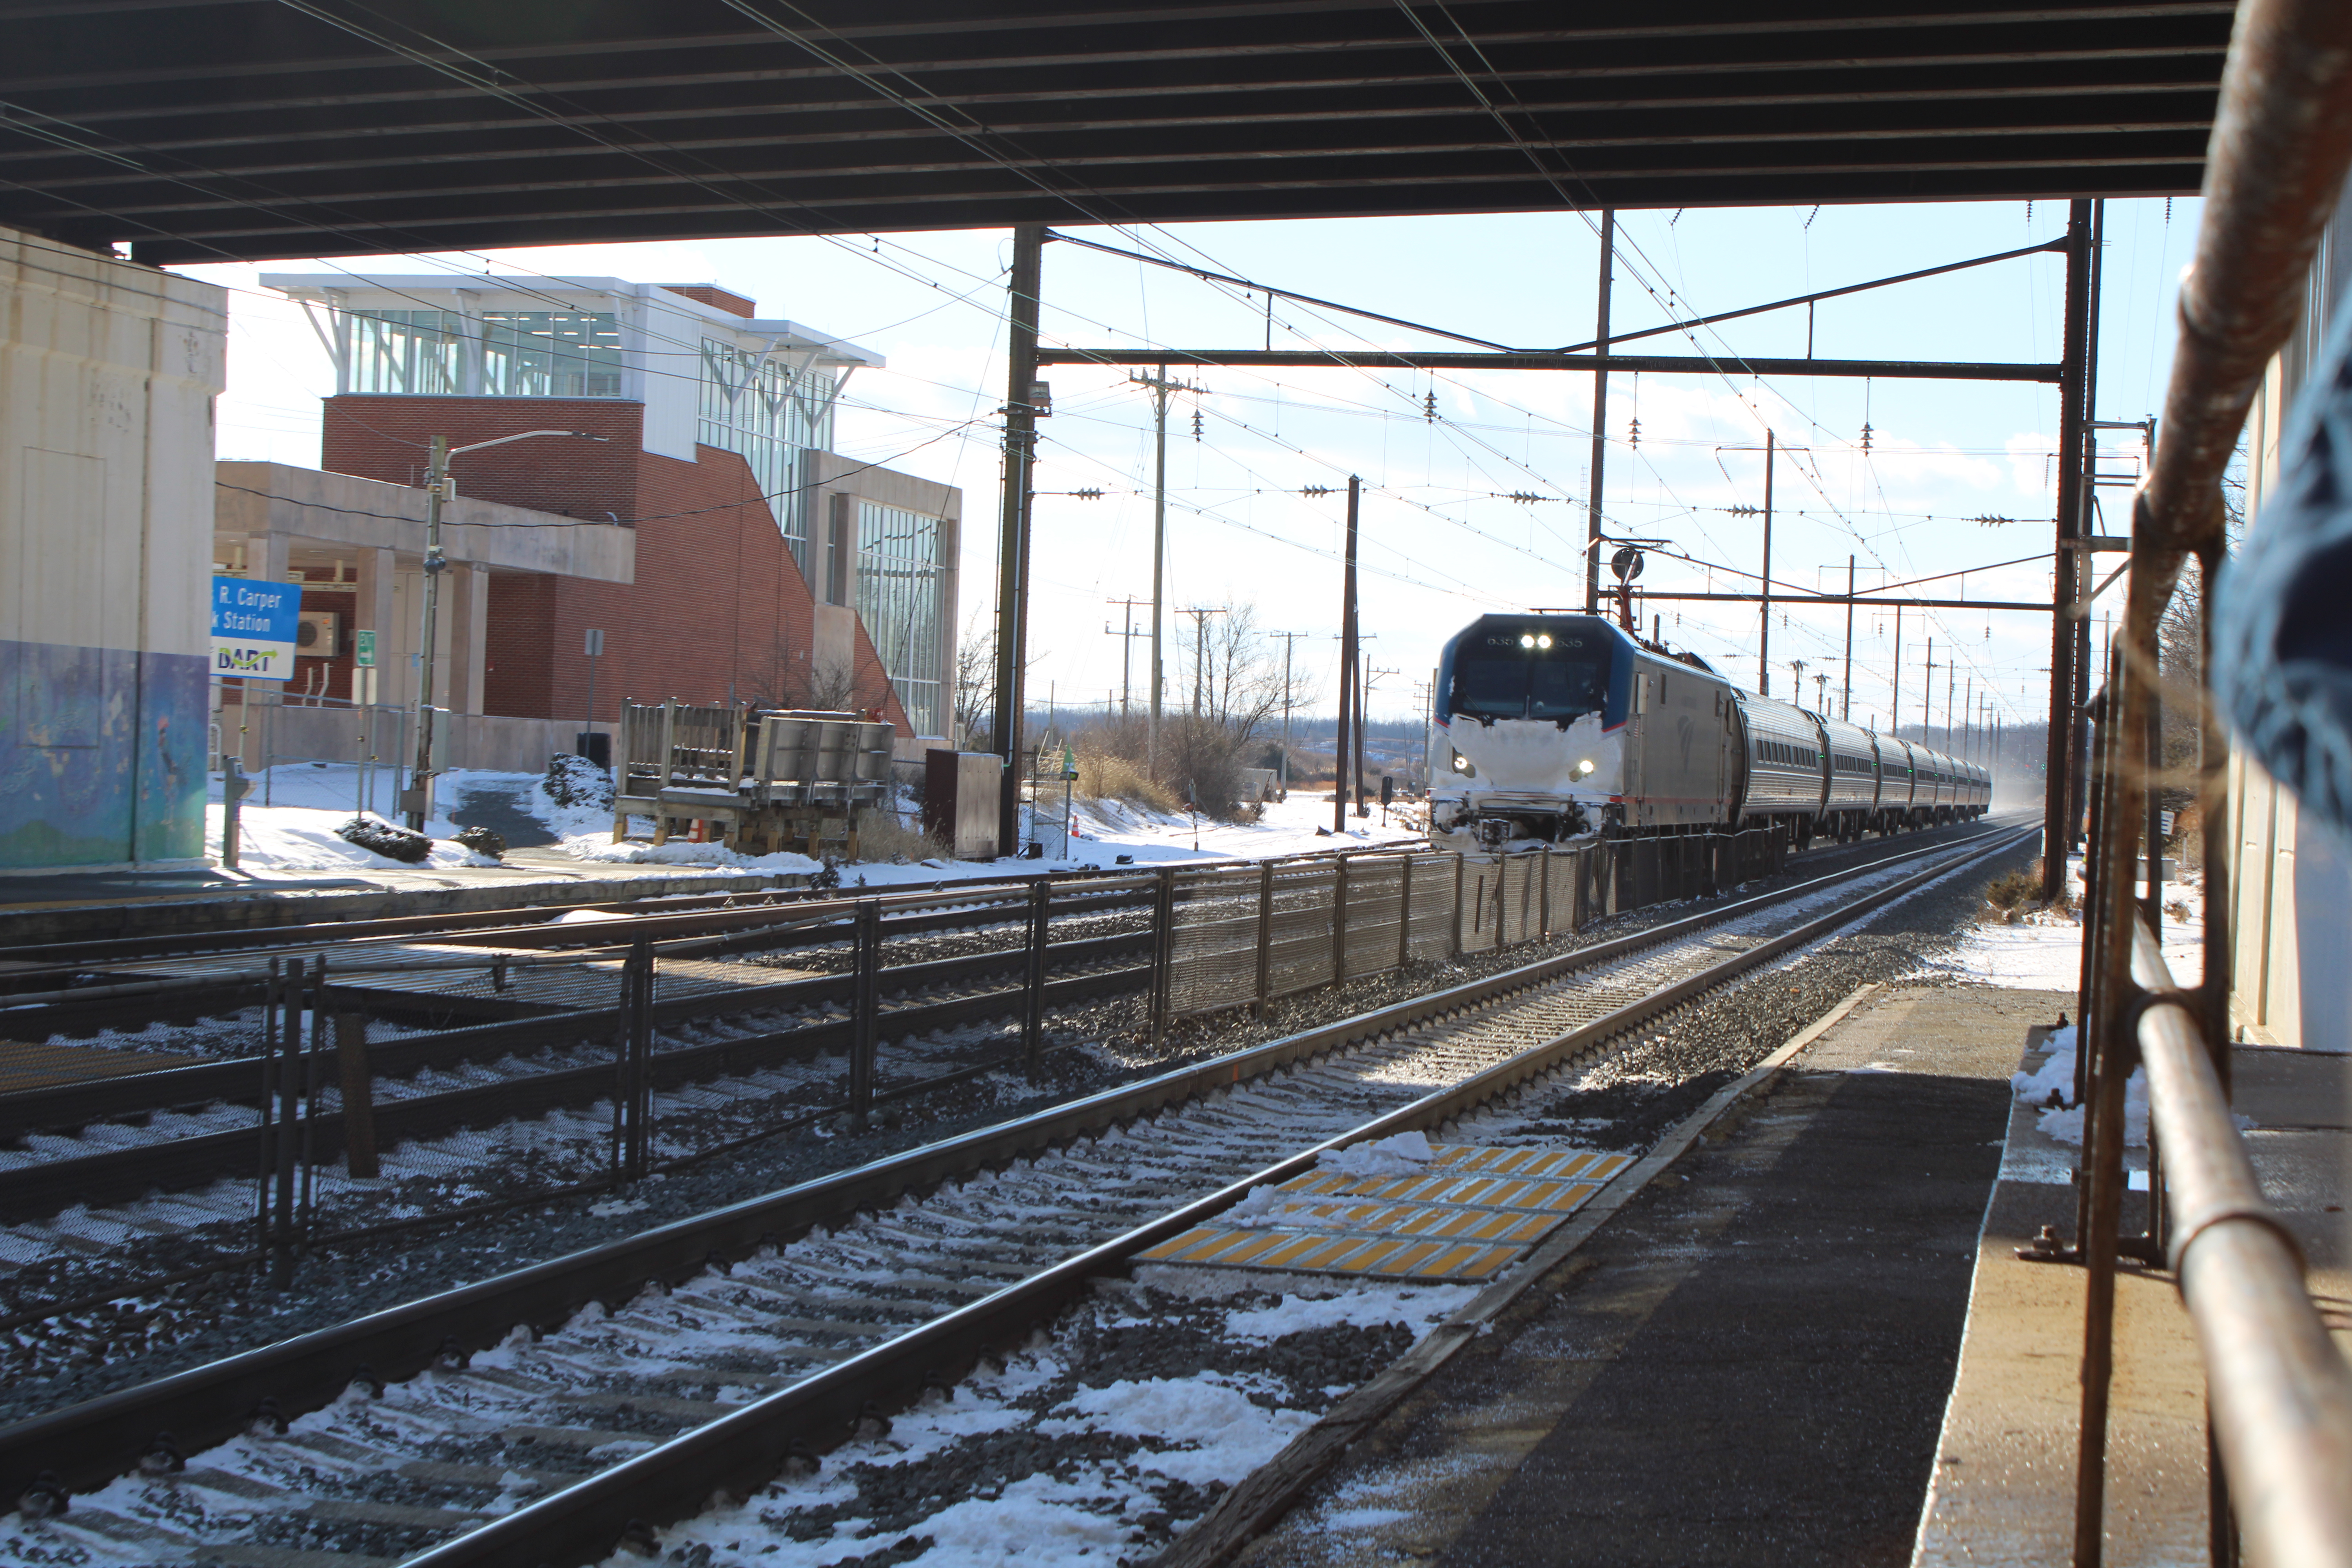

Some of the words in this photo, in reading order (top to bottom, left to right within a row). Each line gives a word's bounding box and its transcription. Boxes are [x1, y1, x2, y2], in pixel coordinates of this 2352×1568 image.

[220, 586, 232, 604] R.
[238, 588, 282, 611] Carper
[223, 611, 271, 632] Station
[360, 633, 374, 646] EXIT
[1488, 635, 1514, 646] 635
[1556, 638, 1583, 648] 635
[218, 648, 274, 671] DART
